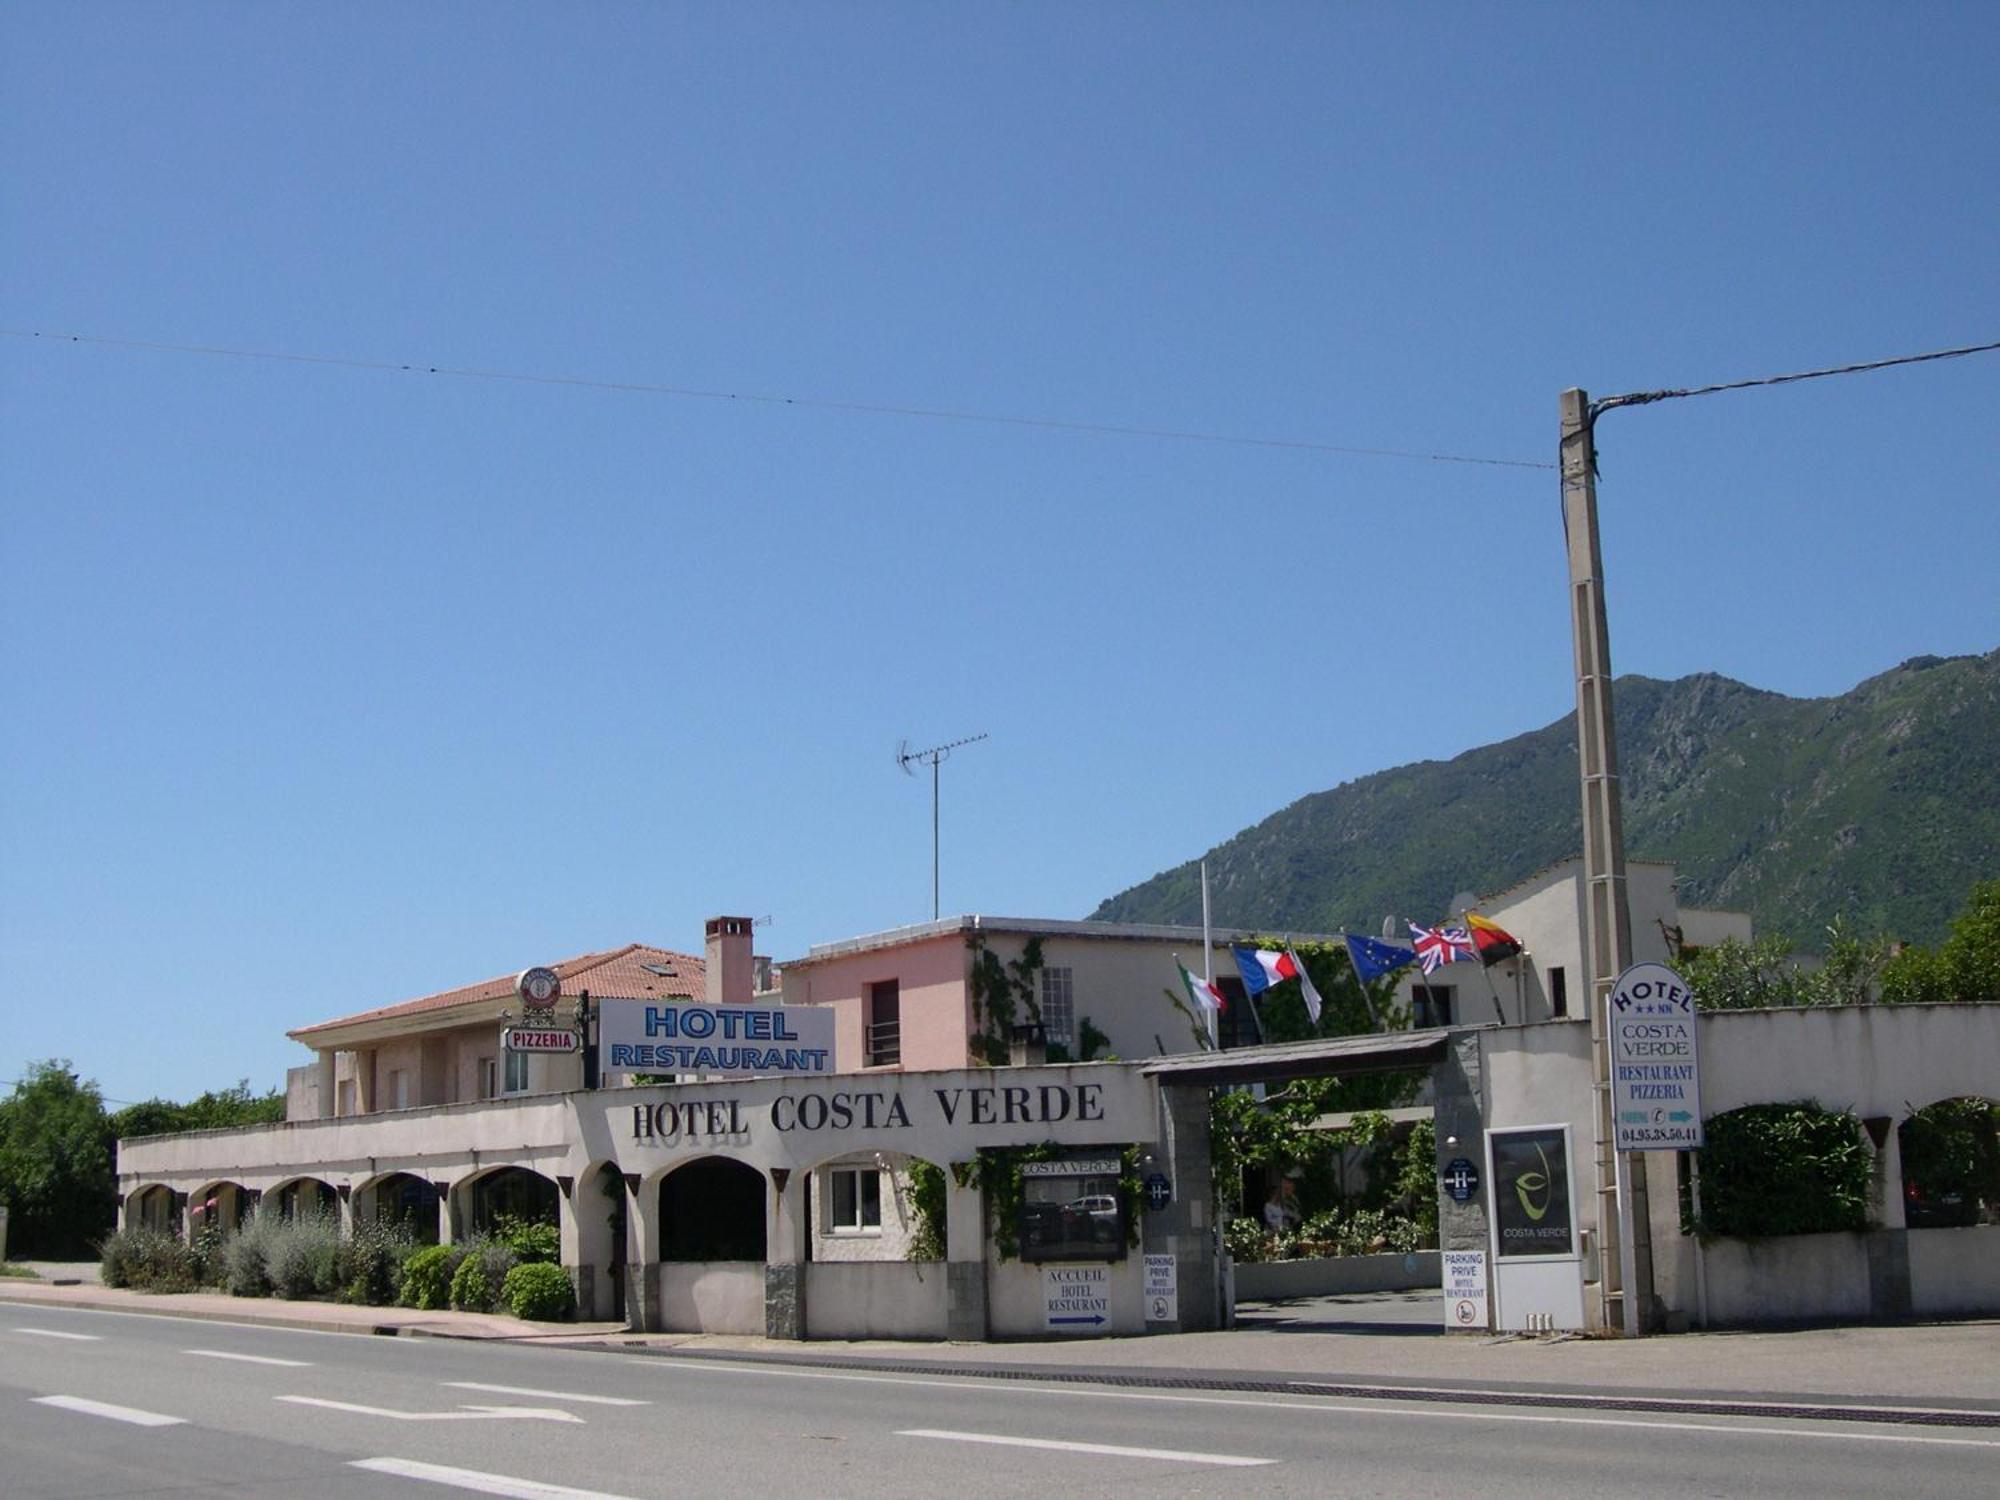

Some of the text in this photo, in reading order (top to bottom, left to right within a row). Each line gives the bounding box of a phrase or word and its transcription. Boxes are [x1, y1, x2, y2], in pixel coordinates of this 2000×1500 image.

[1614, 980, 1692, 1012] HOTEL
[645, 1007, 798, 1040] HOTEL
[1622, 1024, 1687, 1039] COSTA
[514, 1032, 571, 1048] PIZZERIA
[1623, 1042, 1689, 1056] VERDE
[611, 1043, 828, 1071] RESTAURANT
[1619, 1065, 1693, 1081] RESTAURANT
[1630, 1083, 1685, 1100] PIZZERIA
[632, 1083, 1105, 1140] HOTEL COSTA VERDE
[1503, 1227, 1569, 1239] COSTA VERDE
[1445, 1253, 1483, 1265] PARKING
[1048, 1269, 1105, 1281] ACCUEIL
[1451, 1266, 1477, 1276] PRIVE
[1061, 1285, 1092, 1298] HOTEL
[1048, 1298, 1108, 1312] RESTAURANT
